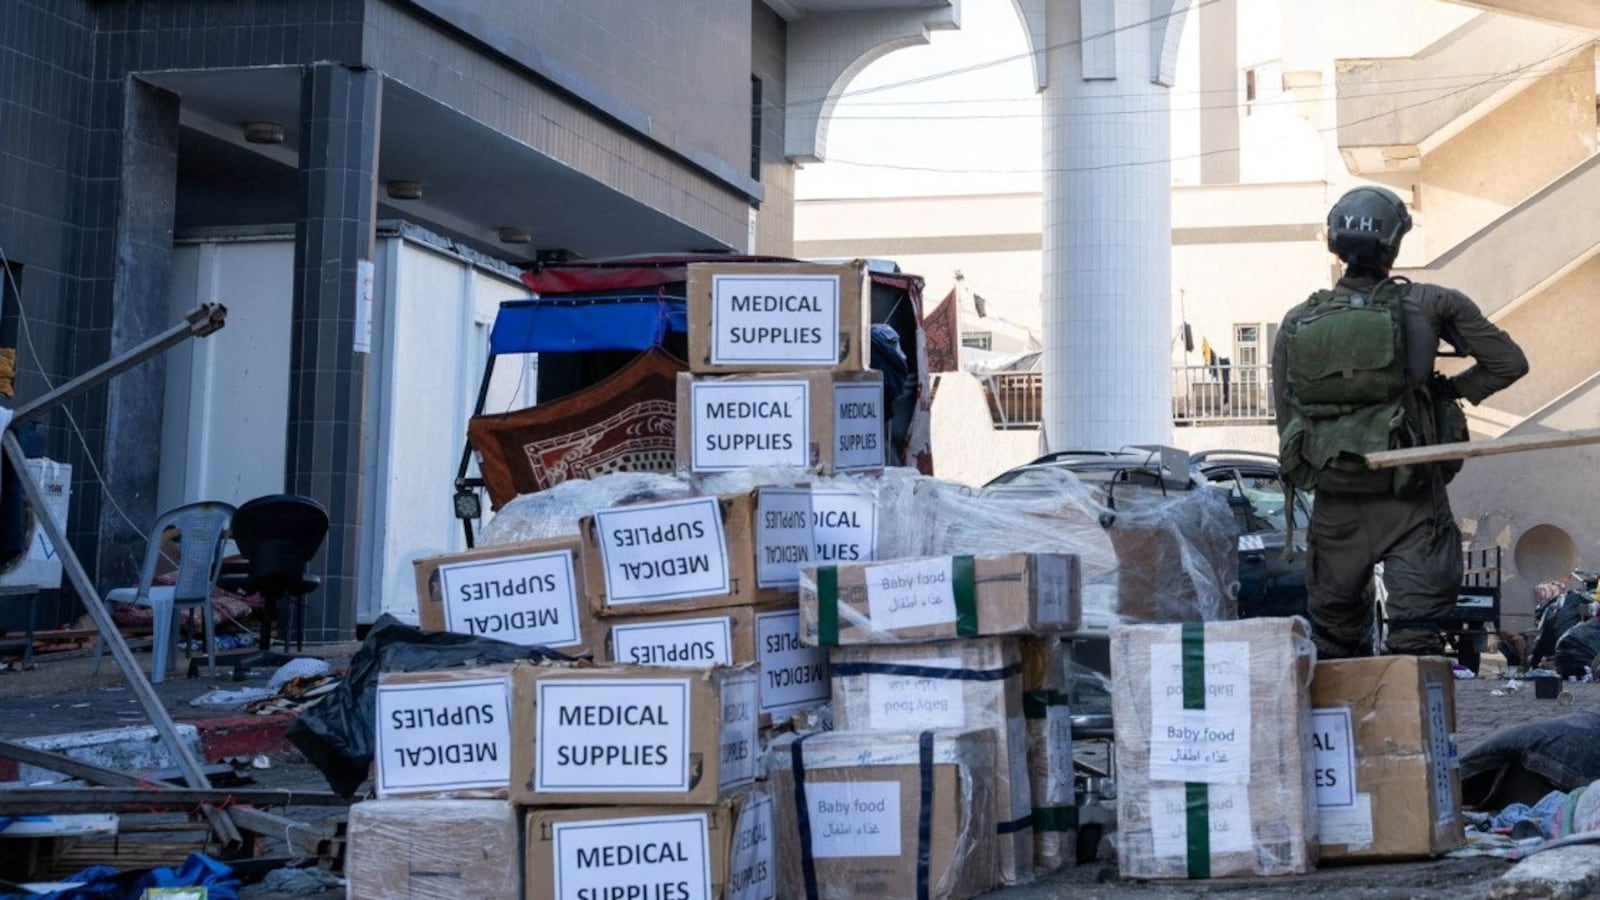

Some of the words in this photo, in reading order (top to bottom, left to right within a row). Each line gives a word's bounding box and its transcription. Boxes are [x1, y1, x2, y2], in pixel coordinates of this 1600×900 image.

[1344, 215, 1379, 232] Y.H.
[731, 296, 822, 312] MEDICAL
[730, 327, 822, 344] SUPPLIES
[706, 402, 792, 419] MEDICAL
[840, 403, 877, 419] MEDICAL
[706, 434, 792, 451] SUPPLIES
[840, 434, 876, 451] SUPPLIES
[765, 511, 807, 528] SUPPLIES
[812, 511, 861, 528] ICAL
[613, 520, 705, 548] SUPPLIES
[765, 545, 809, 563] MEDICAL
[816, 543, 860, 561] LIES
[619, 555, 709, 580] MEDICAL
[882, 577, 914, 590] Baby
[917, 567, 946, 584] food
[460, 574, 556, 602] SUPPLIES
[464, 608, 559, 635] MEDICAL
[630, 641, 715, 664] SUPPLIES
[767, 664, 822, 688] MEDICAL
[1209, 684, 1234, 697] Bab
[917, 698, 950, 713] Baby
[392, 704, 494, 730] SUPPLIES
[559, 705, 668, 726] MEDICAL
[1168, 726, 1200, 742] Baby
[1204, 728, 1236, 742] food
[394, 742, 498, 768] MEDICAL
[557, 745, 668, 766] SUPPLIES
[818, 800, 850, 816] Baby
[854, 798, 886, 813] food
[577, 841, 688, 869] MEDICAL
[731, 860, 768, 894] SUPPLIES
[577, 881, 690, 900] SUPPLIES
